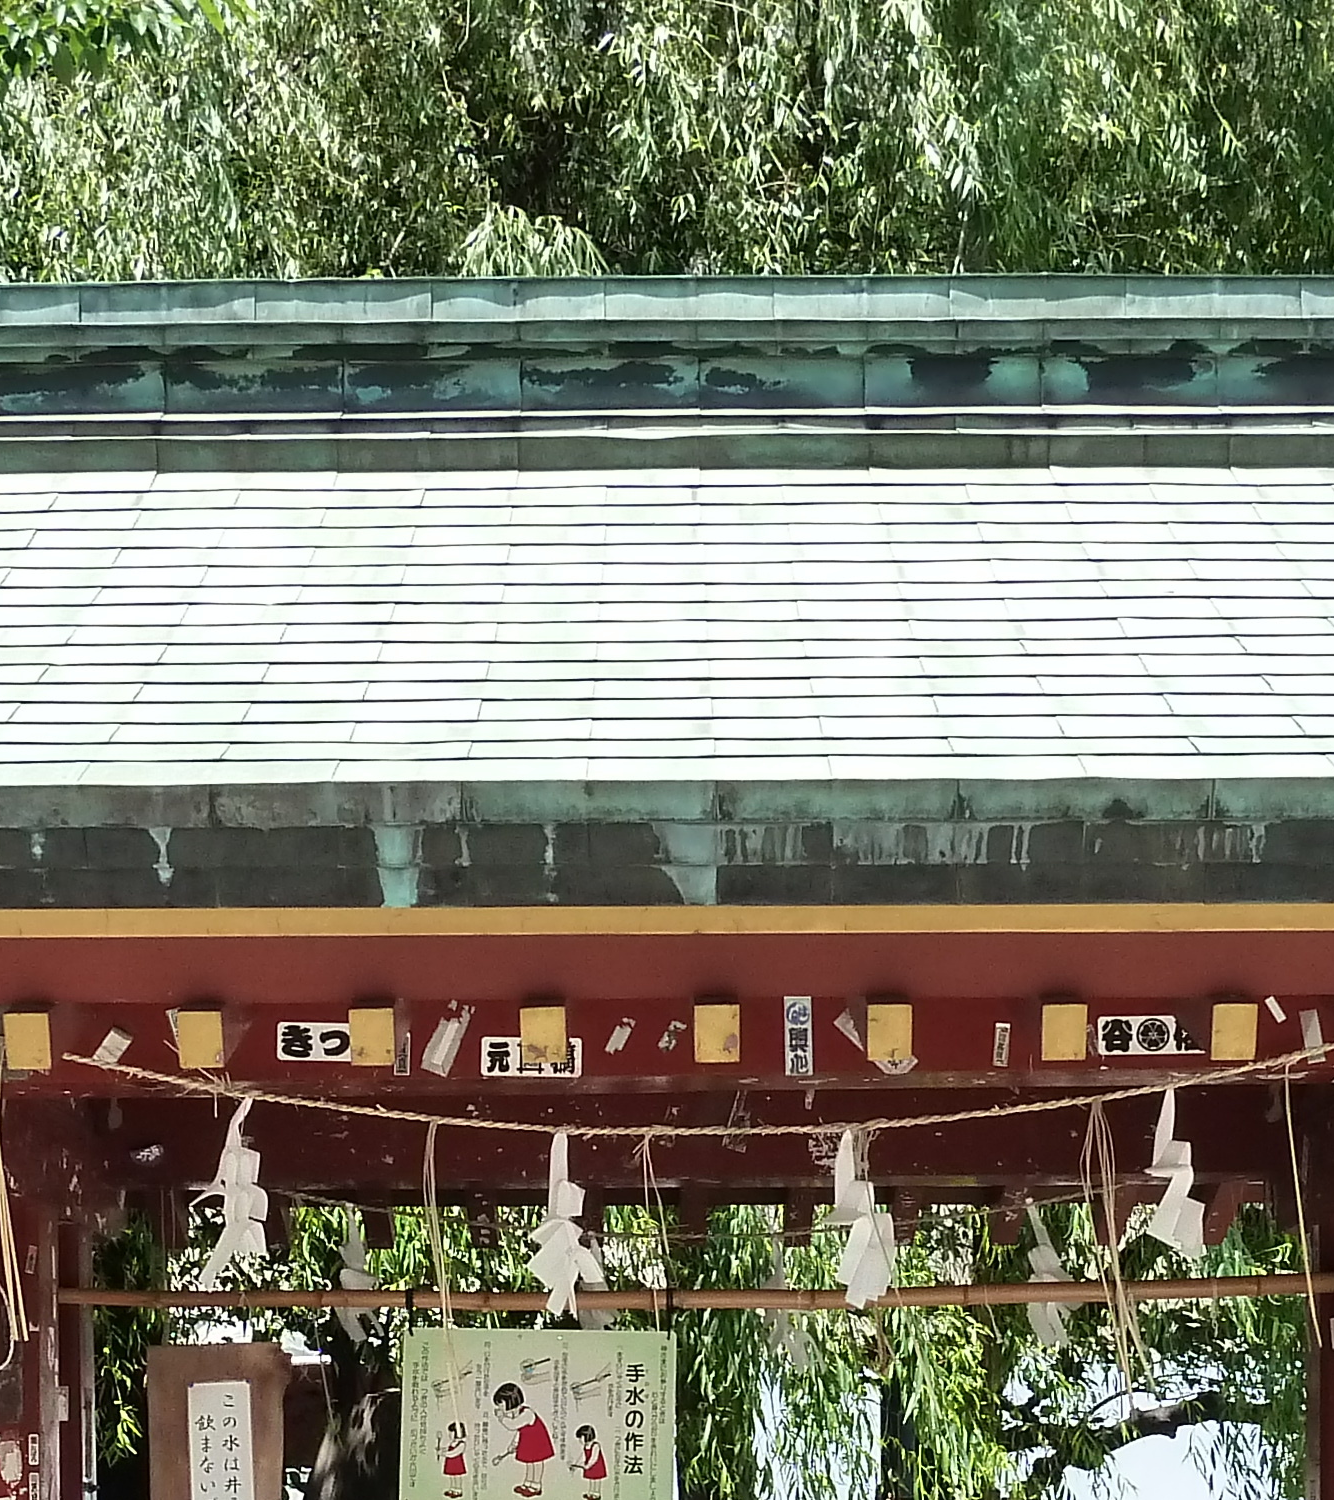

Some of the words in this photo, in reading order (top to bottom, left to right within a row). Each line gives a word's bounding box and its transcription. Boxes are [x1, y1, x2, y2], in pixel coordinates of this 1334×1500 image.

[623, 1363, 645, 1475] 手水の作法
